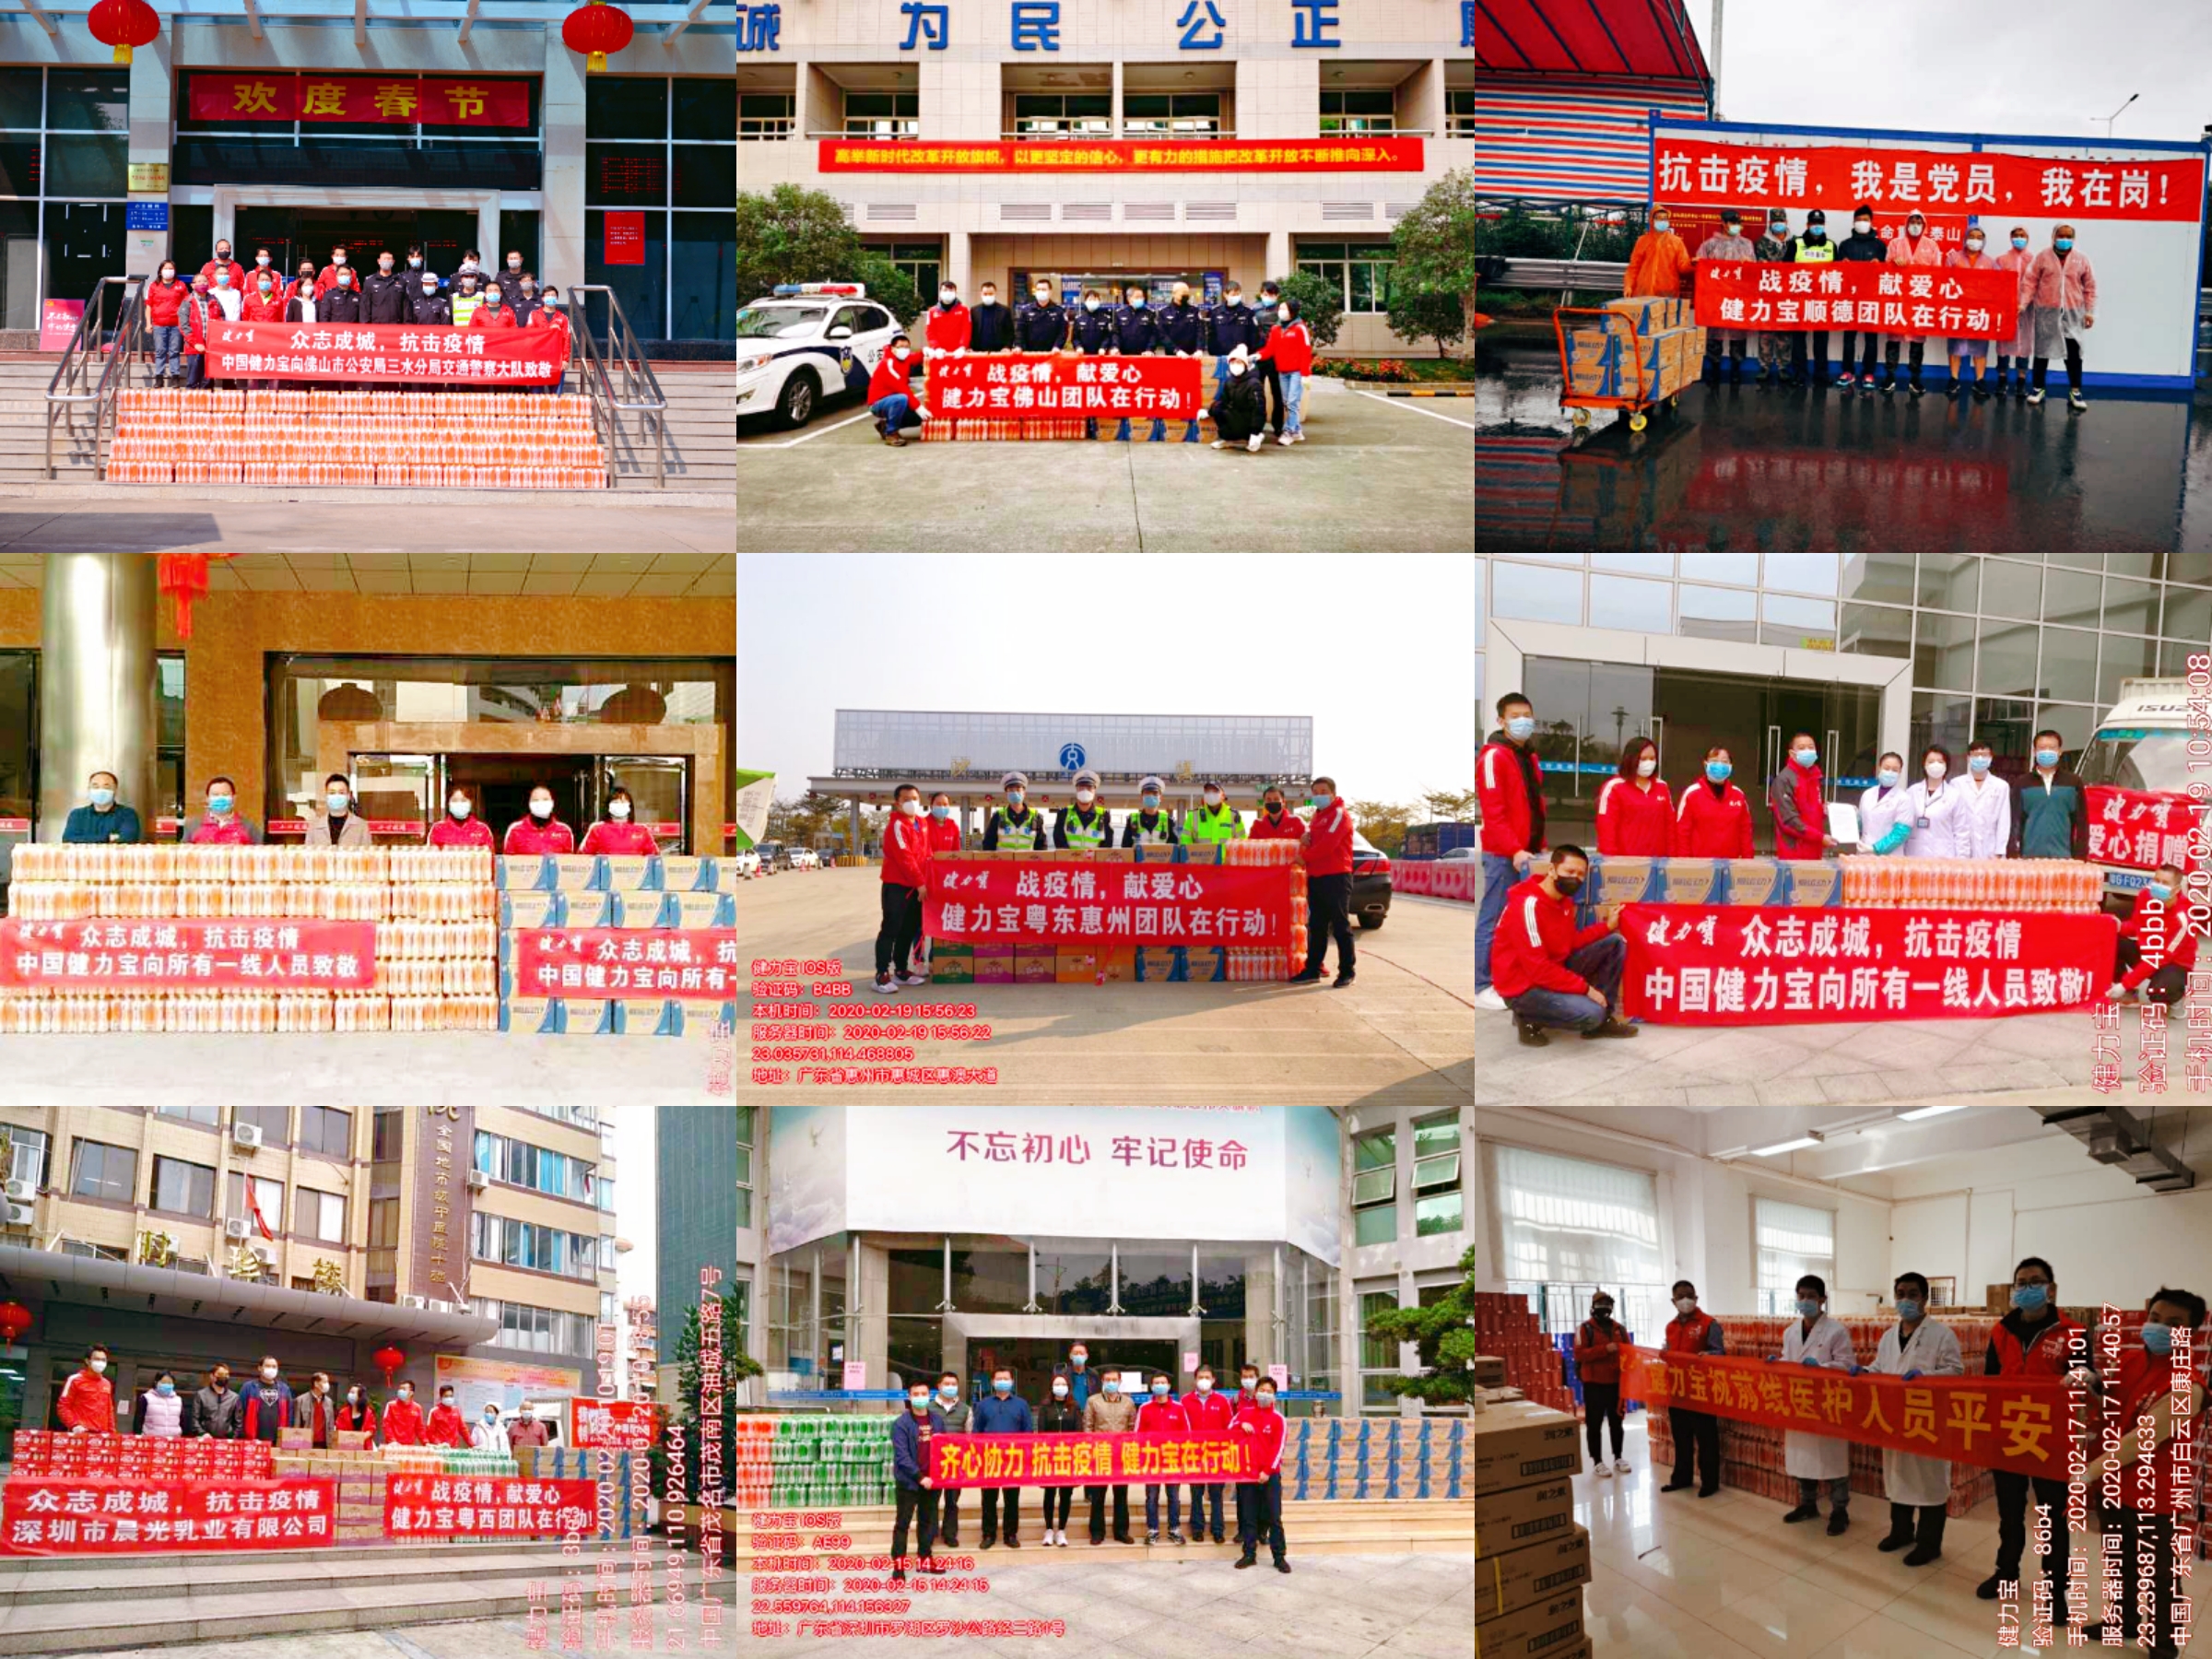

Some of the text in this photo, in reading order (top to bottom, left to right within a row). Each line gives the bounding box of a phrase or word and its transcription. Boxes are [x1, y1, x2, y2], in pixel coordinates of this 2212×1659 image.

[900, 2, 1060, 51] 为民
[1177, 2, 1341, 49] 公正
[233, 81, 489, 120] 欢度春节
[1659, 149, 2169, 209] 抗击疫情，我是党员，我在岗！
[1759, 268, 1964, 301] 战疫情，献爱心
[1719, 297, 2003, 333] 健力宝顺德团队在行动！
[289, 329, 486, 355] 众志成城，抗击疫情
[221, 353, 553, 378] 中国健力宝向佛山市公安局三水分局交通警察大队致敬
[986, 363, 1143, 383] 战疫情，献爱心
[941, 386, 1192, 409] 健力宝佛山团队在行动！
[1016, 869, 1204, 900] 战疫情，献爱心
[940, 902, 1277, 938] 健力宝粤东惠州团队在行动！
[79, 924, 300, 950] 众志成城，抗击疫情
[1739, 913, 2022, 960] 众志成城，抗击疫情
[16, 951, 359, 979] 中国健力宝向所有一线人员致敬
[1644, 965, 2093, 1013] 中国健力宝向所有一线人员致敬！
[945, 1129, 1249, 1171] 不忘初心 牢记使命
[939, 1439, 1252, 1479] 齐心协力 抗击疫情 健力宝在行动！
[26, 1488, 321, 1514] 众志成城，抗击疫情
[430, 1482, 560, 1505] 战疫情，献爱心
[11, 1515, 327, 1544] 深圳市晨光乳业有限公司
